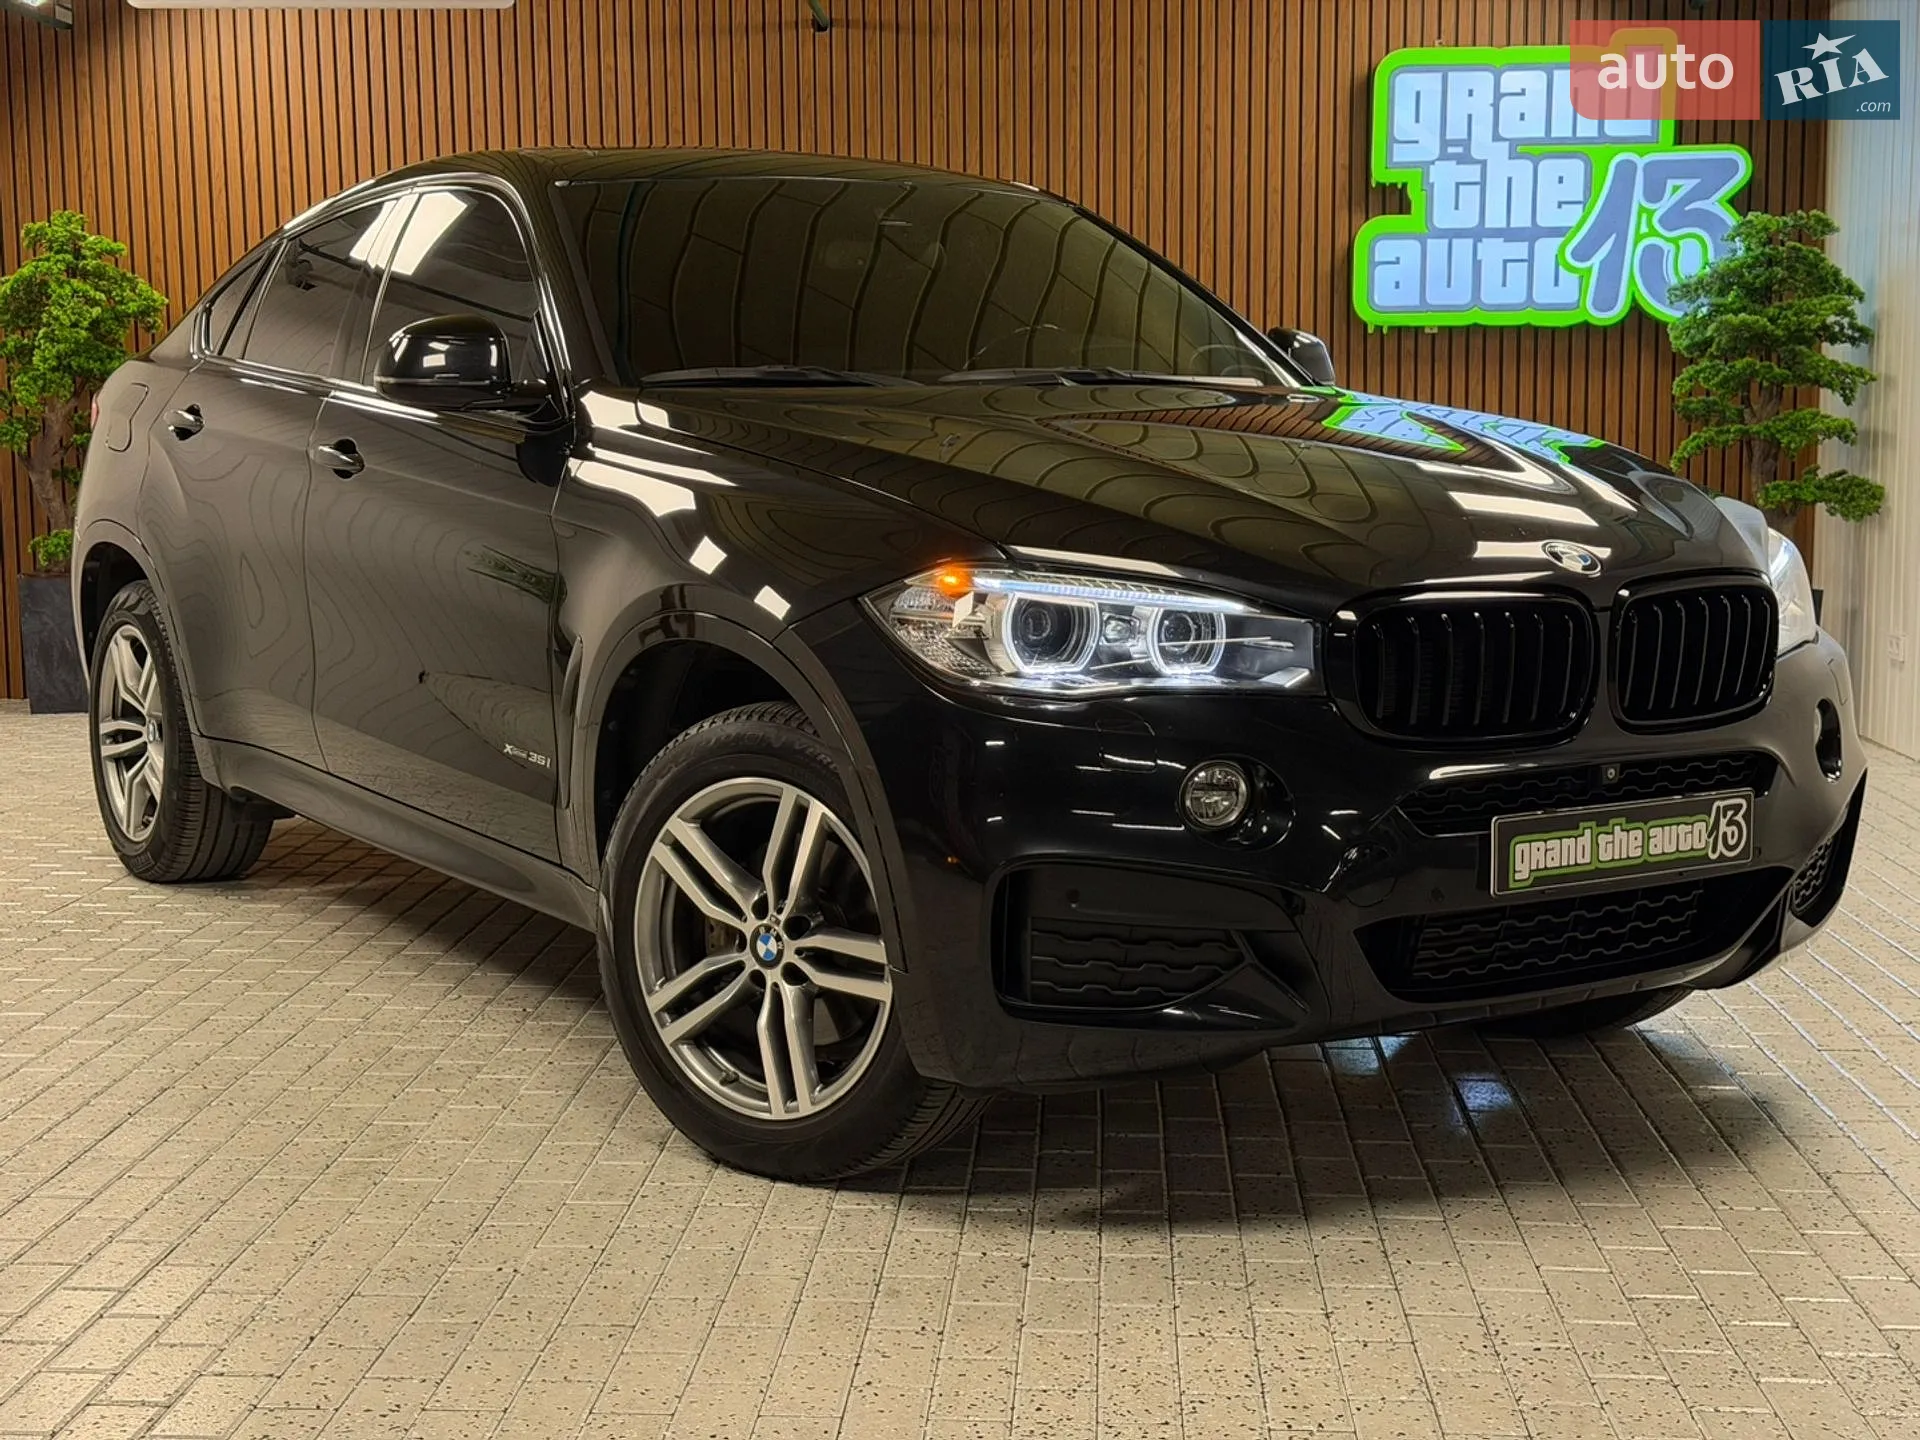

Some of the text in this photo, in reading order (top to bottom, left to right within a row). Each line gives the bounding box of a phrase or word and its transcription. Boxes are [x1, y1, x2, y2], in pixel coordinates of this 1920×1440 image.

[1428, 142, 1586, 229] the
[1372, 237, 1582, 308] auto
[1513, 799, 1747, 881] grand the auto 13
